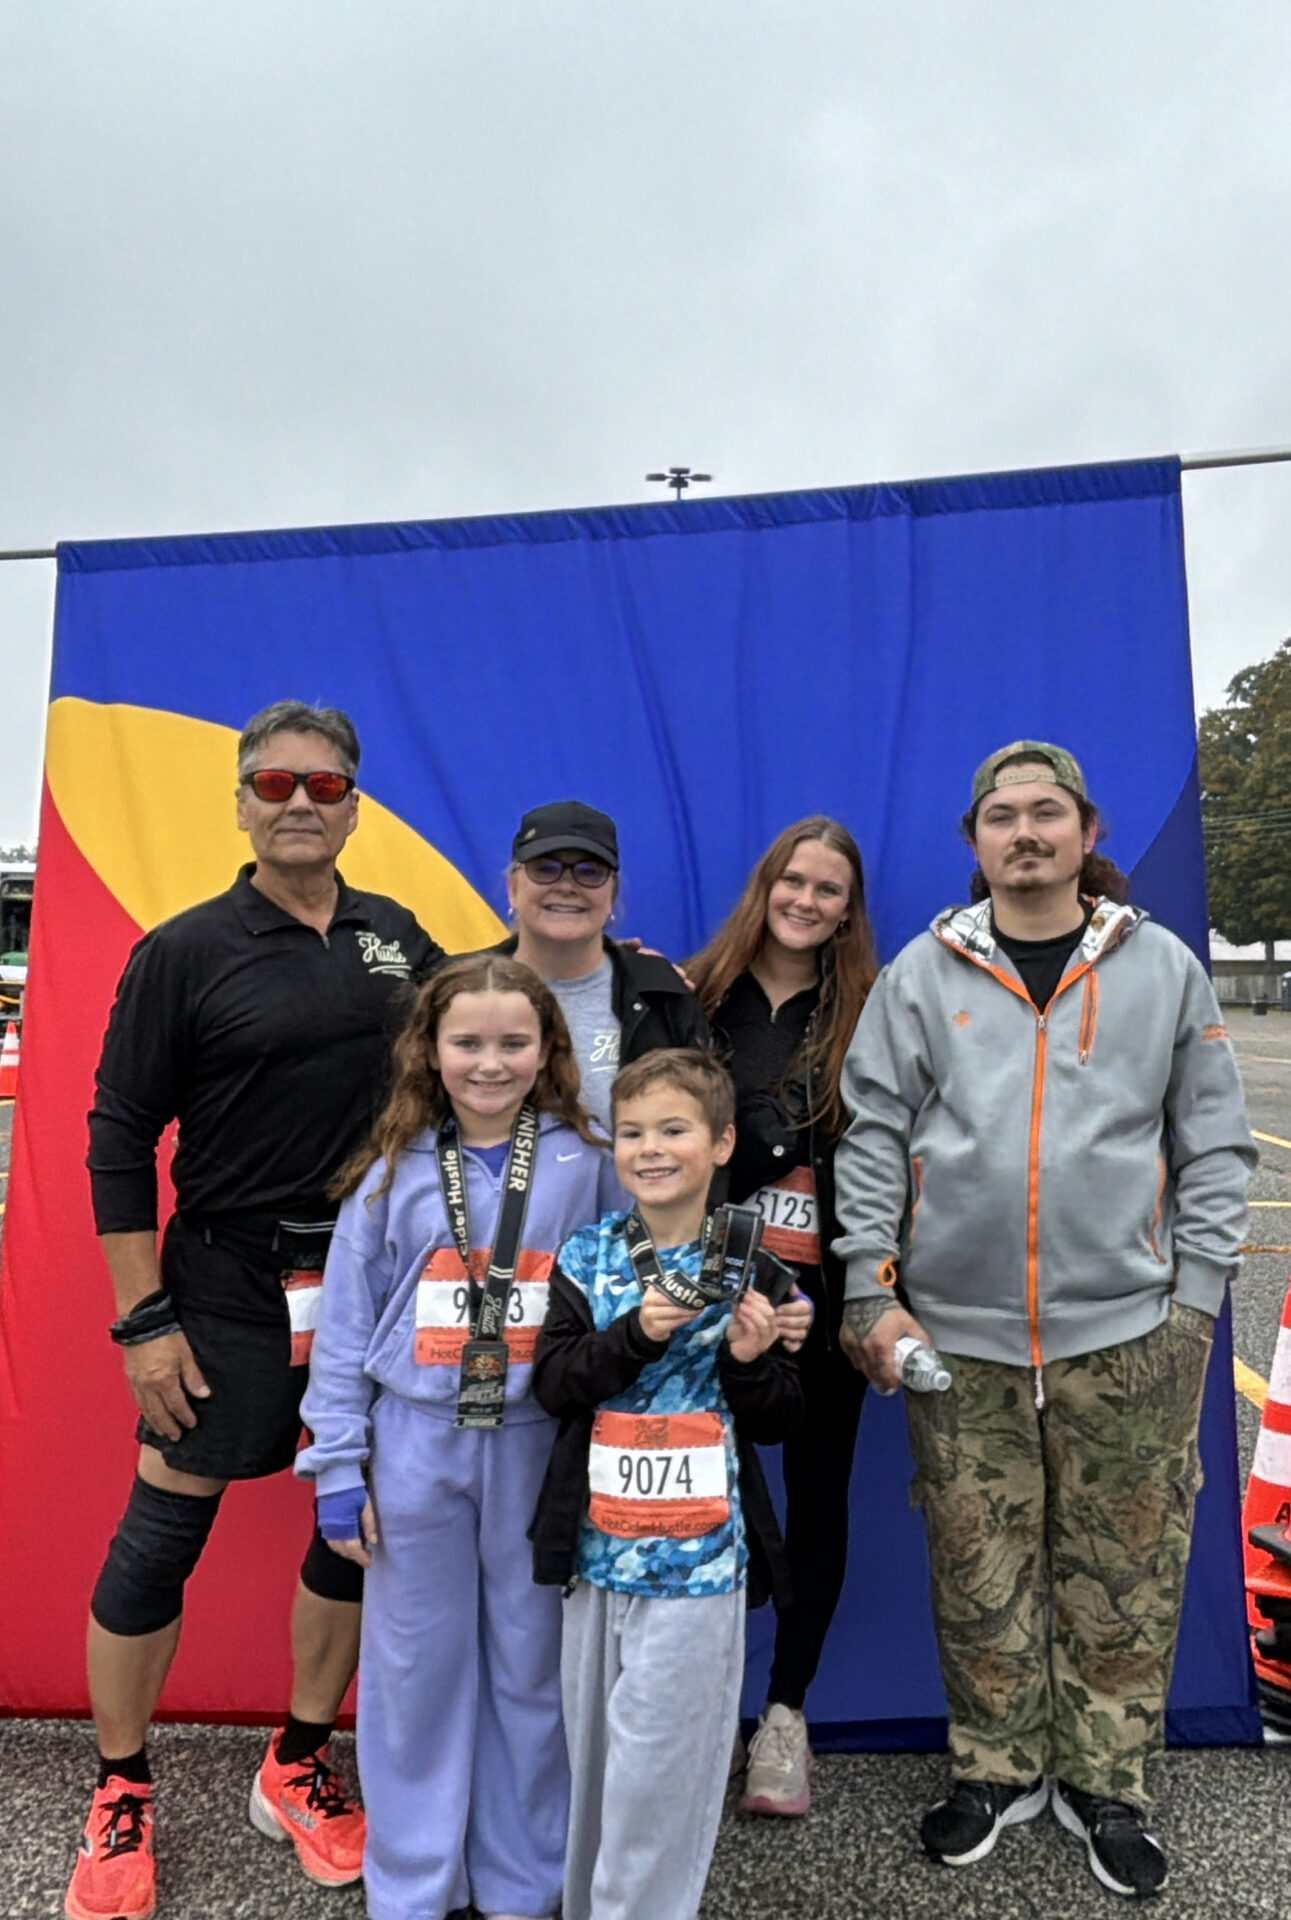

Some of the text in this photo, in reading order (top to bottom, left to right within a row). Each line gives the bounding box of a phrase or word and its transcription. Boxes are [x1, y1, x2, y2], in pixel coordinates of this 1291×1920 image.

[358, 936, 407, 963] Hustle
[508, 1103, 536, 1192] FINISHER
[441, 1149, 463, 1205] Hustle
[755, 1190, 814, 1229] 5125
[453, 1287, 524, 1324] 93
[618, 1454, 694, 1496] 9074
